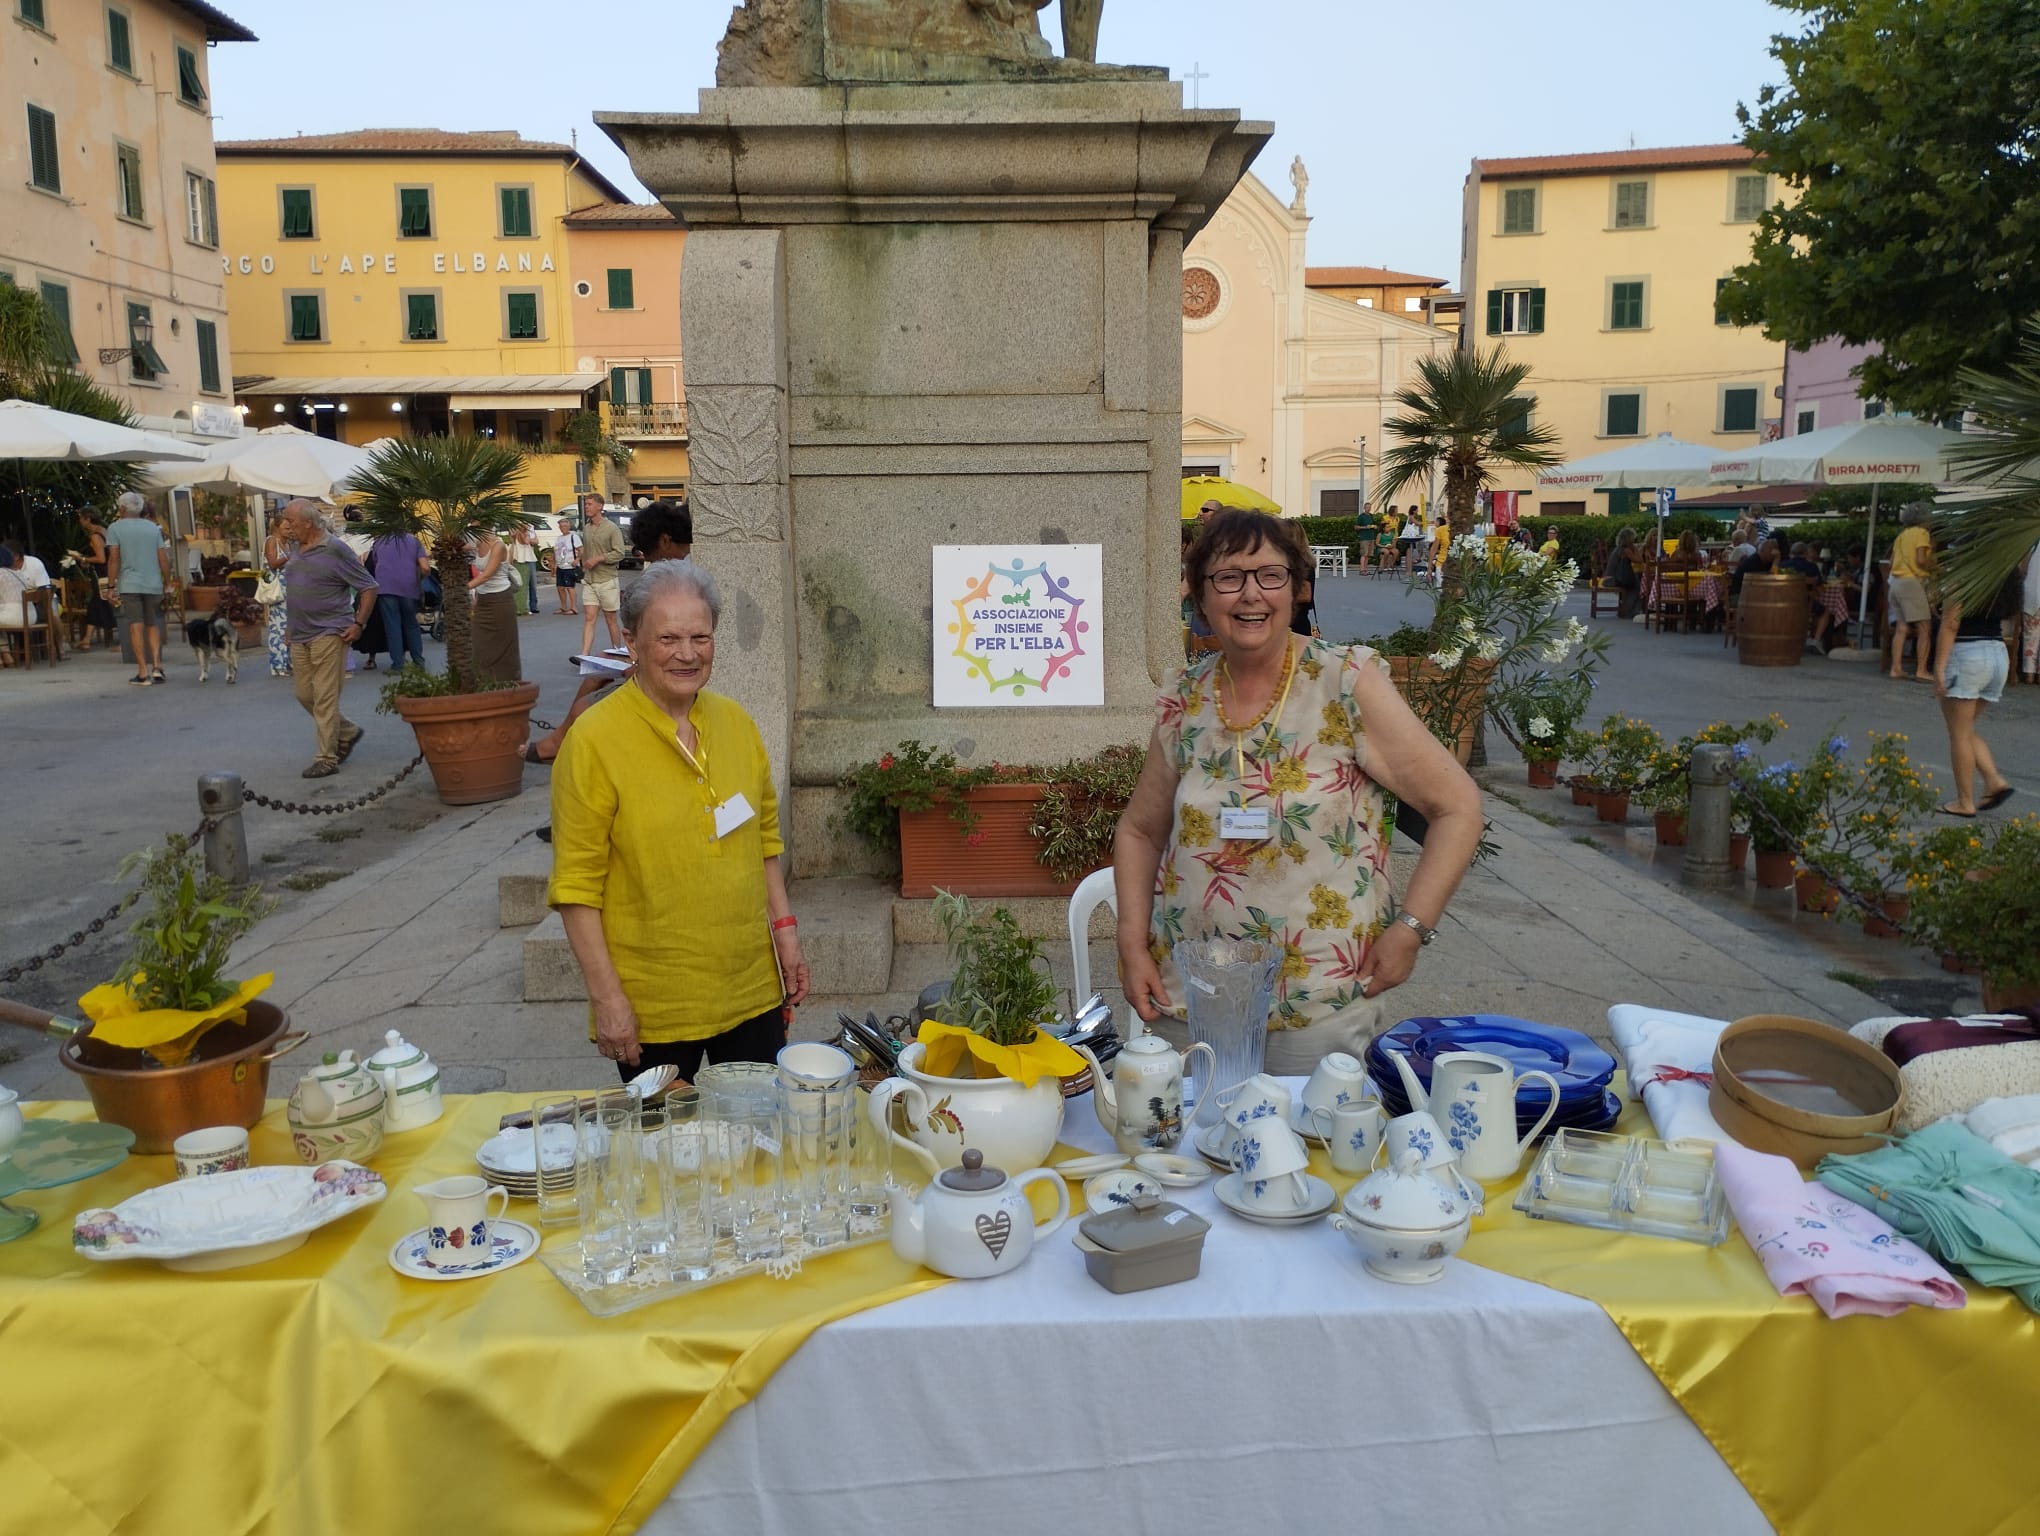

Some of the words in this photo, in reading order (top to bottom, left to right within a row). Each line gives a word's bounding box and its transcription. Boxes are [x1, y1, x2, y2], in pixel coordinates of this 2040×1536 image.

[310, 253, 397, 275] L'APE
[434, 252, 556, 273] ELBANA
[1828, 464, 1866, 476] BIRRA
[1867, 463, 1920, 475] MORETTI
[1540, 477, 1564, 485] BIRRA
[1566, 474, 1603, 483] MORETTI
[972, 609, 1065, 620] ASSOCIAZIONE
[994, 623, 1043, 634] INSIEME
[975, 637, 1006, 650] PER
[1010, 637, 1065, 650] L'ELBA
